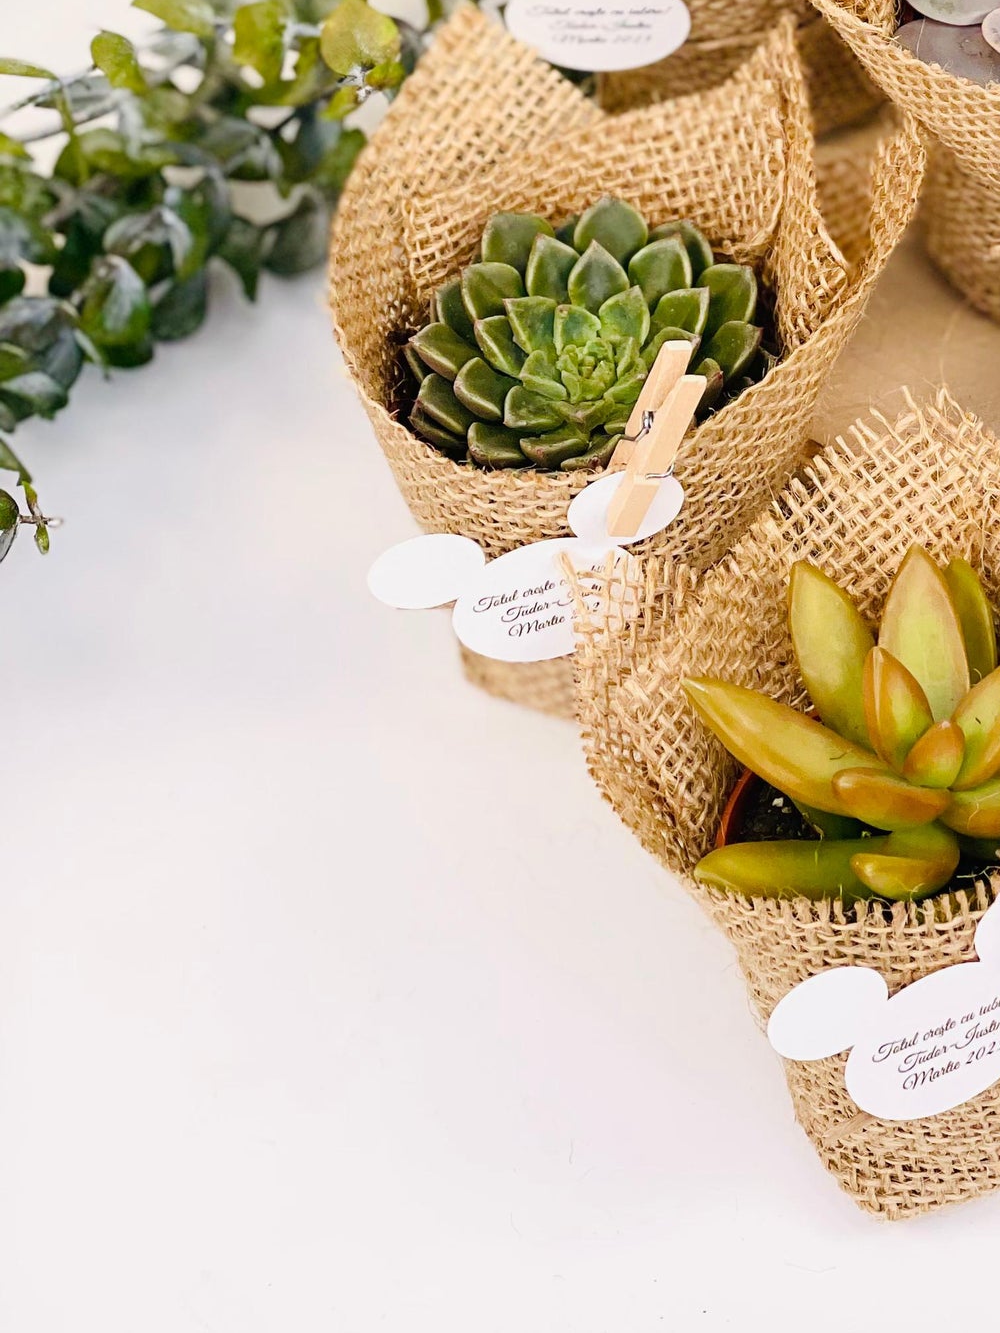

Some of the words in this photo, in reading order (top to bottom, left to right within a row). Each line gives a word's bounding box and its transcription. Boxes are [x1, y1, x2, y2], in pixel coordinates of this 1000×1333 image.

[472, 589, 518, 613] Totul
[872, 1032, 919, 1063] Totul
[960, 1011, 976, 1025] cu
[902, 1059, 961, 1090] Martie
